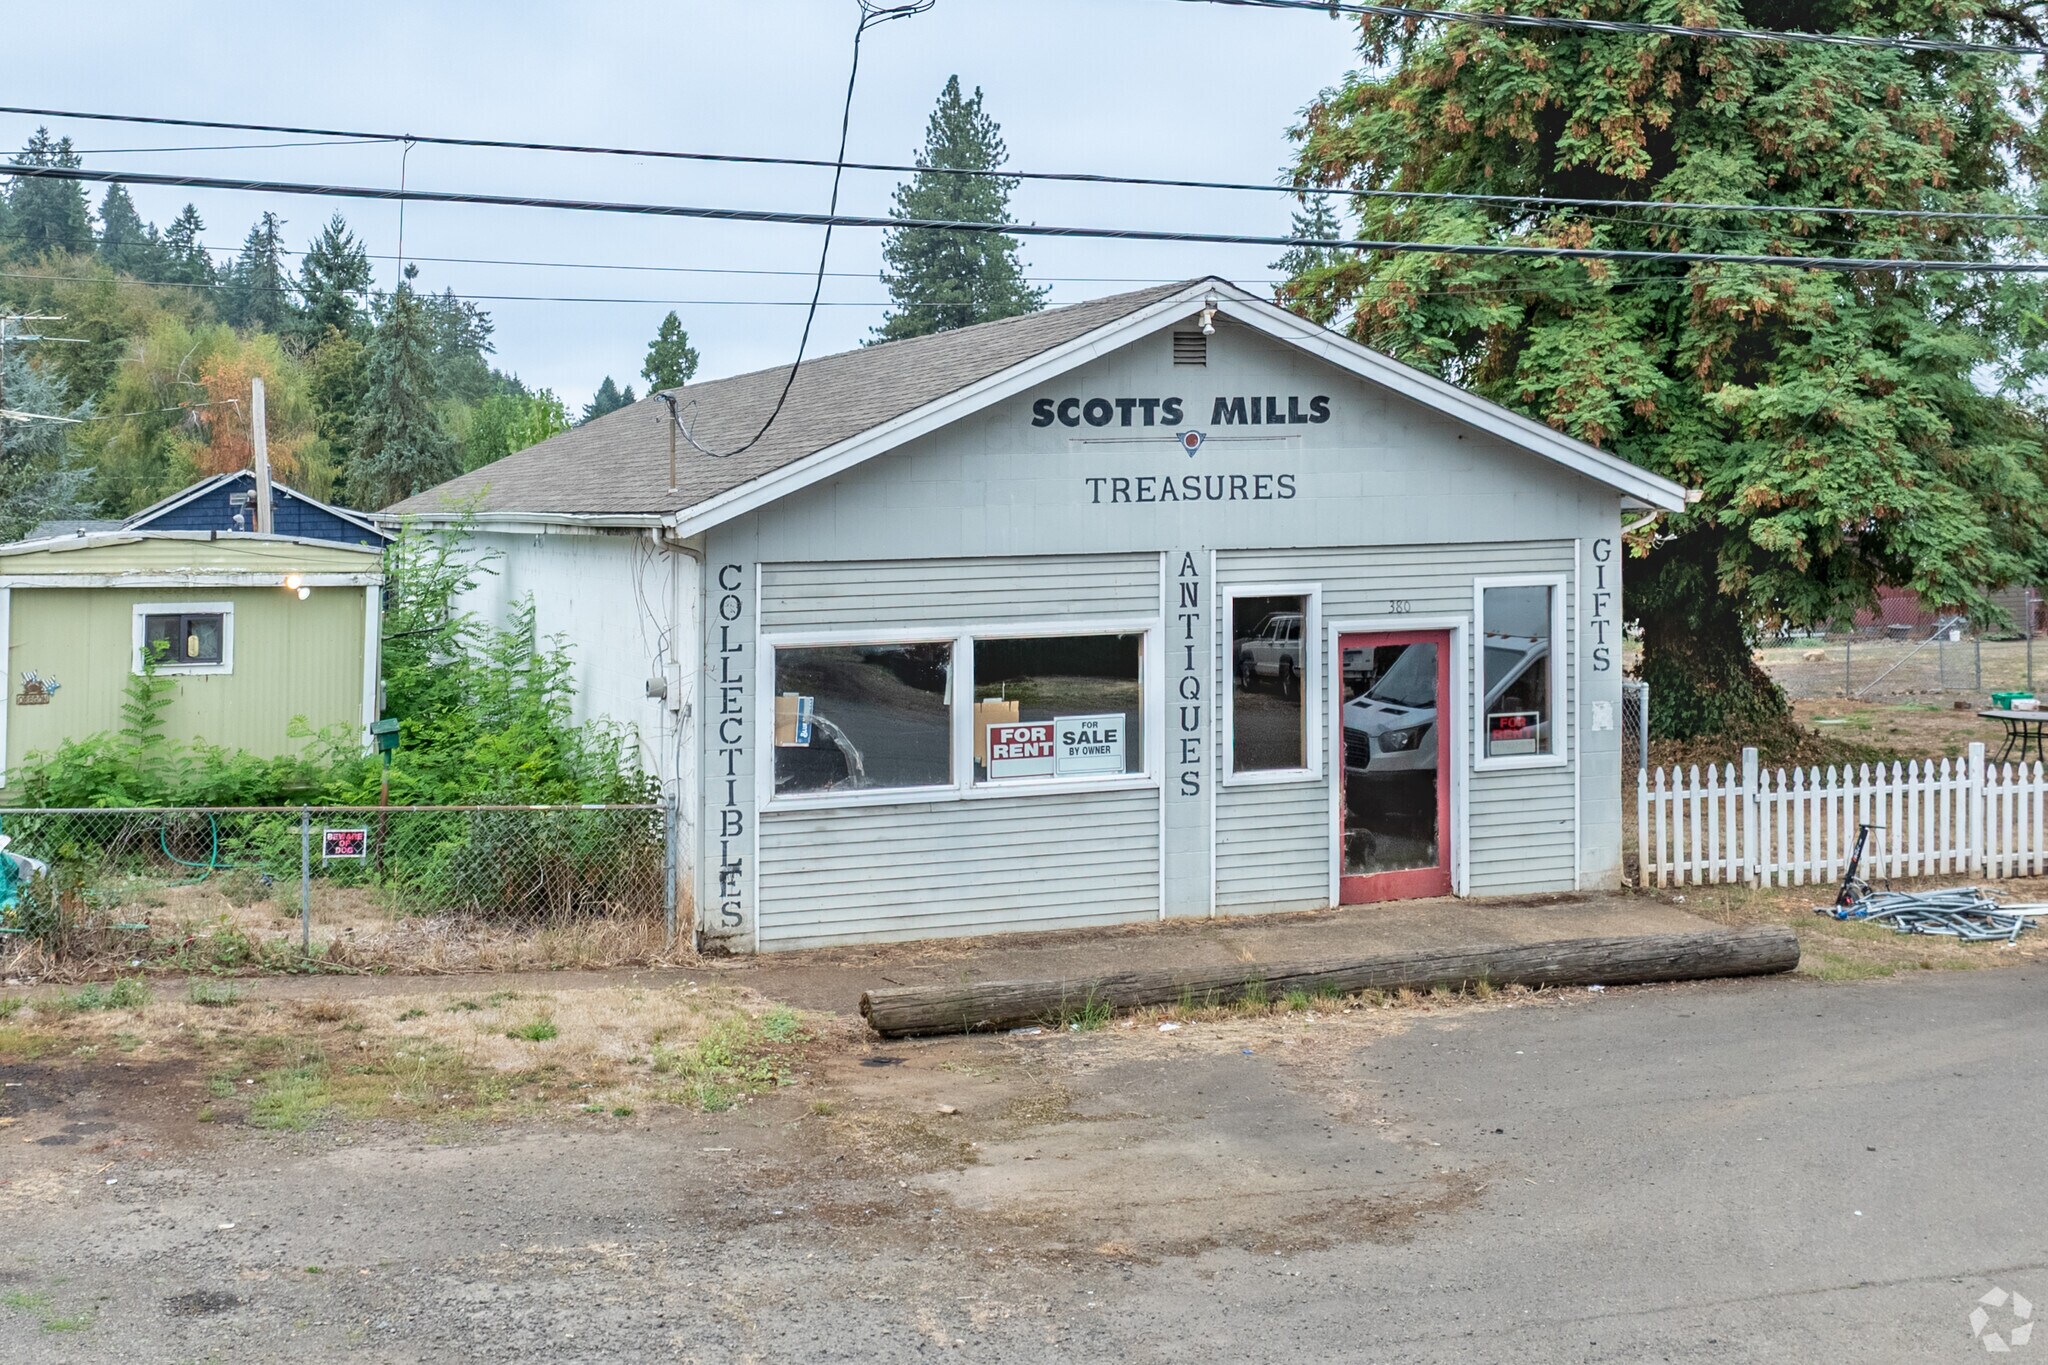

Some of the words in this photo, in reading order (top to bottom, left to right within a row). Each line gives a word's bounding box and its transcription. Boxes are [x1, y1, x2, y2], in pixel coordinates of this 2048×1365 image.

[1031, 397, 1184, 427] SCOTTS
[1210, 395, 1331, 425] MILLS
[1085, 474, 1297, 504] TREASURES
[1389, 600, 1411, 614] 380
[1591, 538, 1611, 671] GIFTS
[1178, 551, 1201, 796] ANTIQUES
[1081, 721, 1098, 729] FOR
[1500, 717, 1526, 728] FOR
[1000, 727, 1046, 743] FOR
[1062, 729, 1117, 745] SALE
[1492, 729, 1531, 740] RENT
[718, 564, 743, 928] COLLECTIBLES
[993, 742, 1053, 759] RENT
[1069, 747, 1080, 756] BY
[1082, 745, 1111, 756] OWNER
